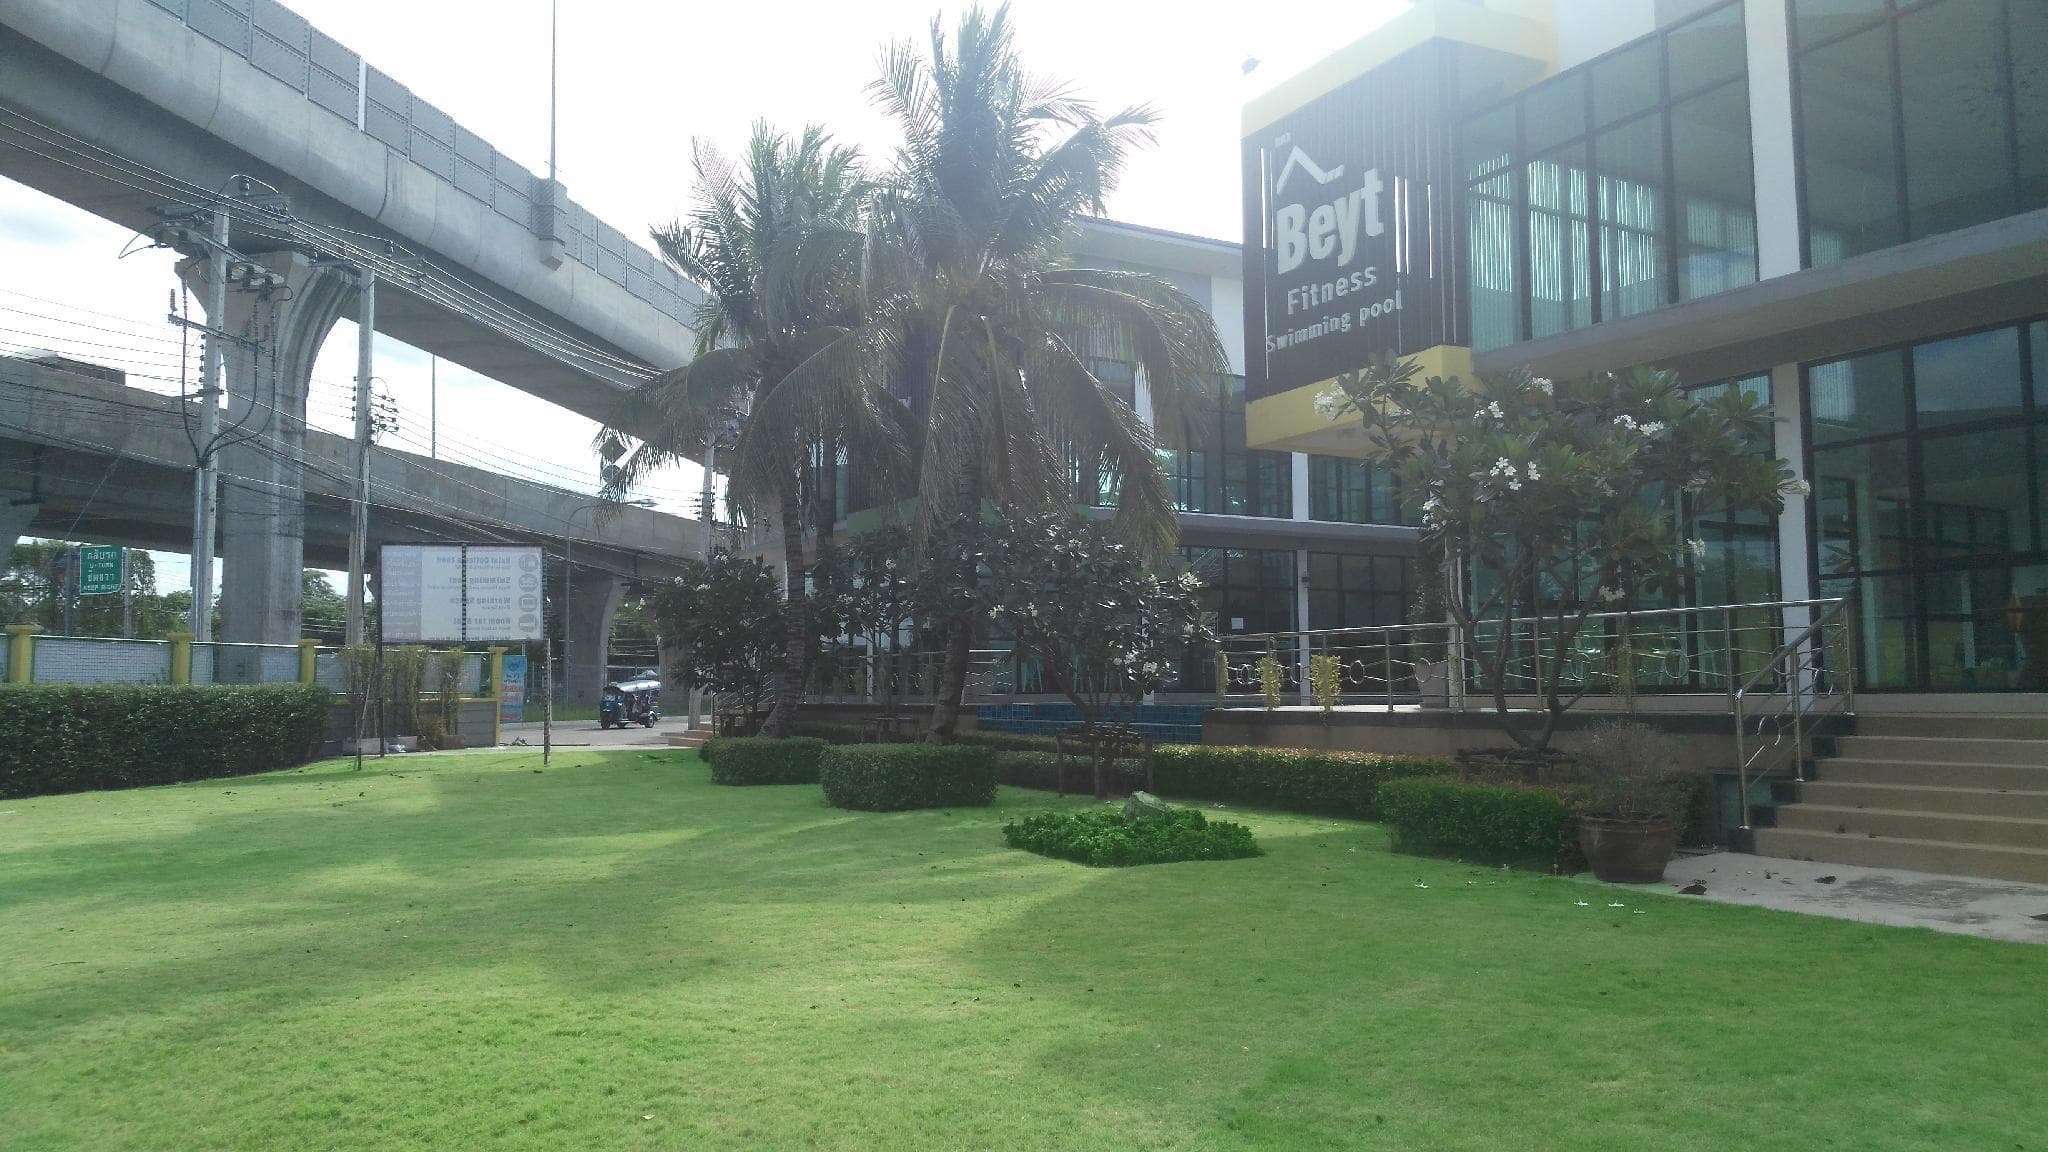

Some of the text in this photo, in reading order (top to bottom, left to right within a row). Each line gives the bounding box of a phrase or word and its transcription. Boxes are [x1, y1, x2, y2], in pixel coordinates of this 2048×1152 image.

[1276, 167, 1385, 275] Beyt
[1266, 289, 1403, 353] Swimming pool
[1287, 266, 1377, 315] Fitness
